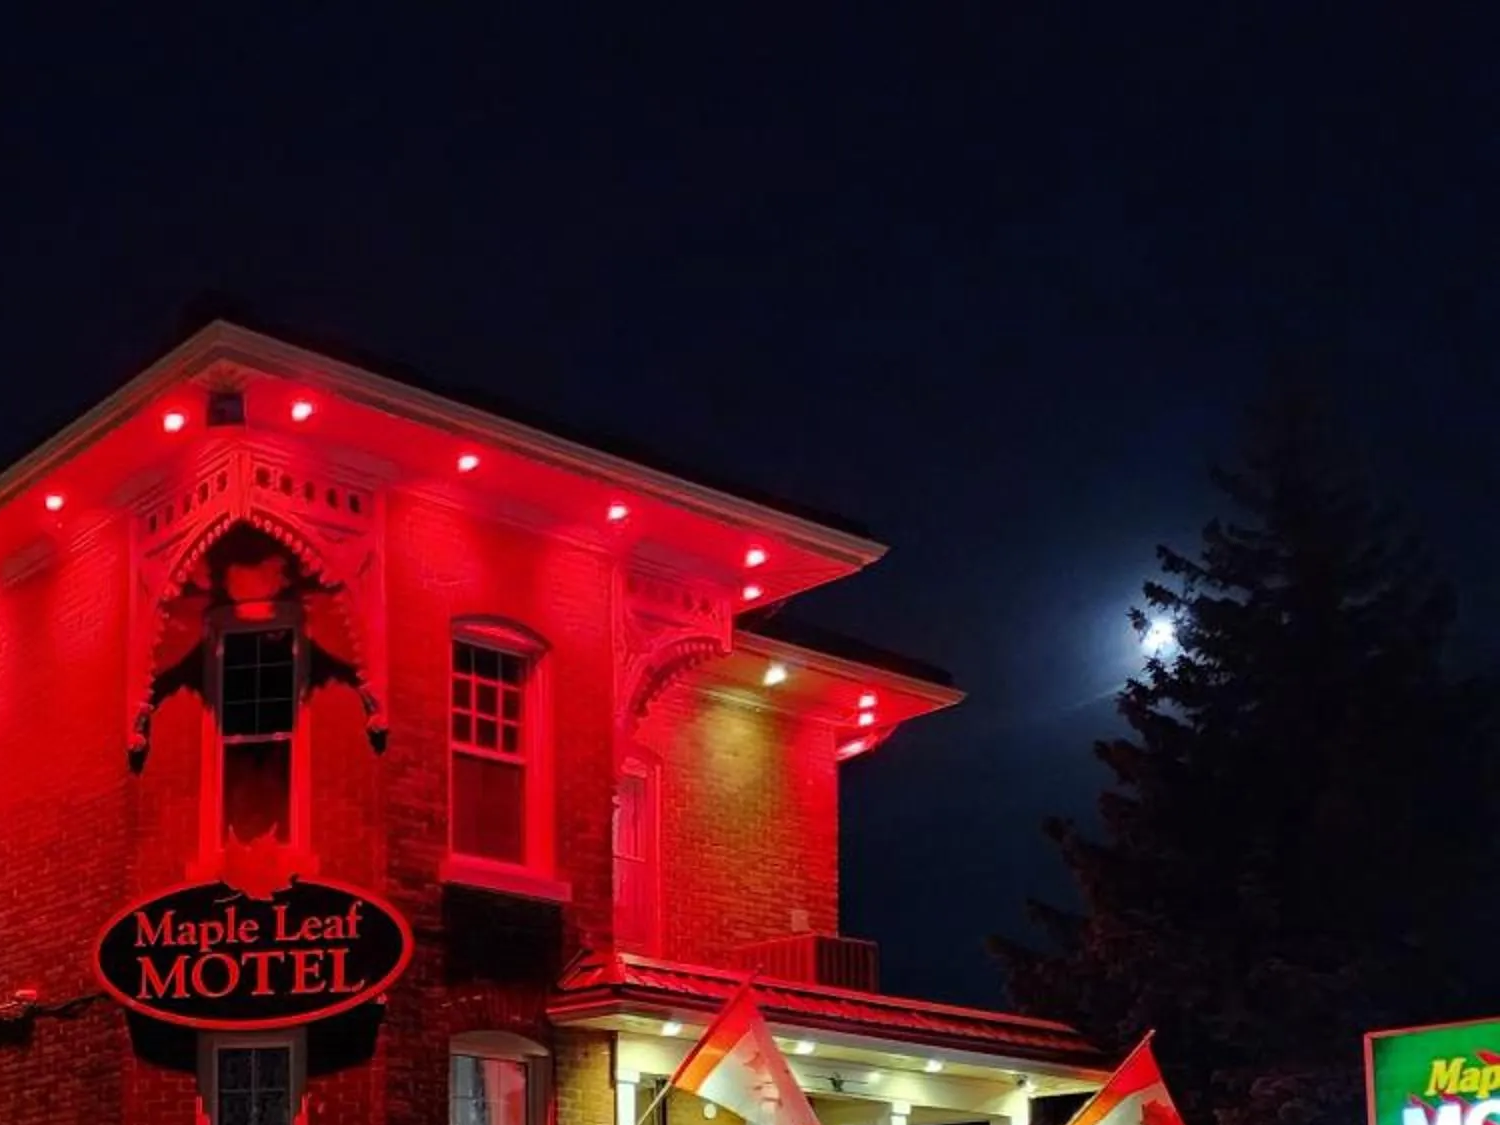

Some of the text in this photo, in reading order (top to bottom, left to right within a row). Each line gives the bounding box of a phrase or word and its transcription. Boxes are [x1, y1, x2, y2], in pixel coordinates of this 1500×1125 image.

[134, 901, 363, 952] Maple Leaf
[136, 948, 365, 999] MOTEL
